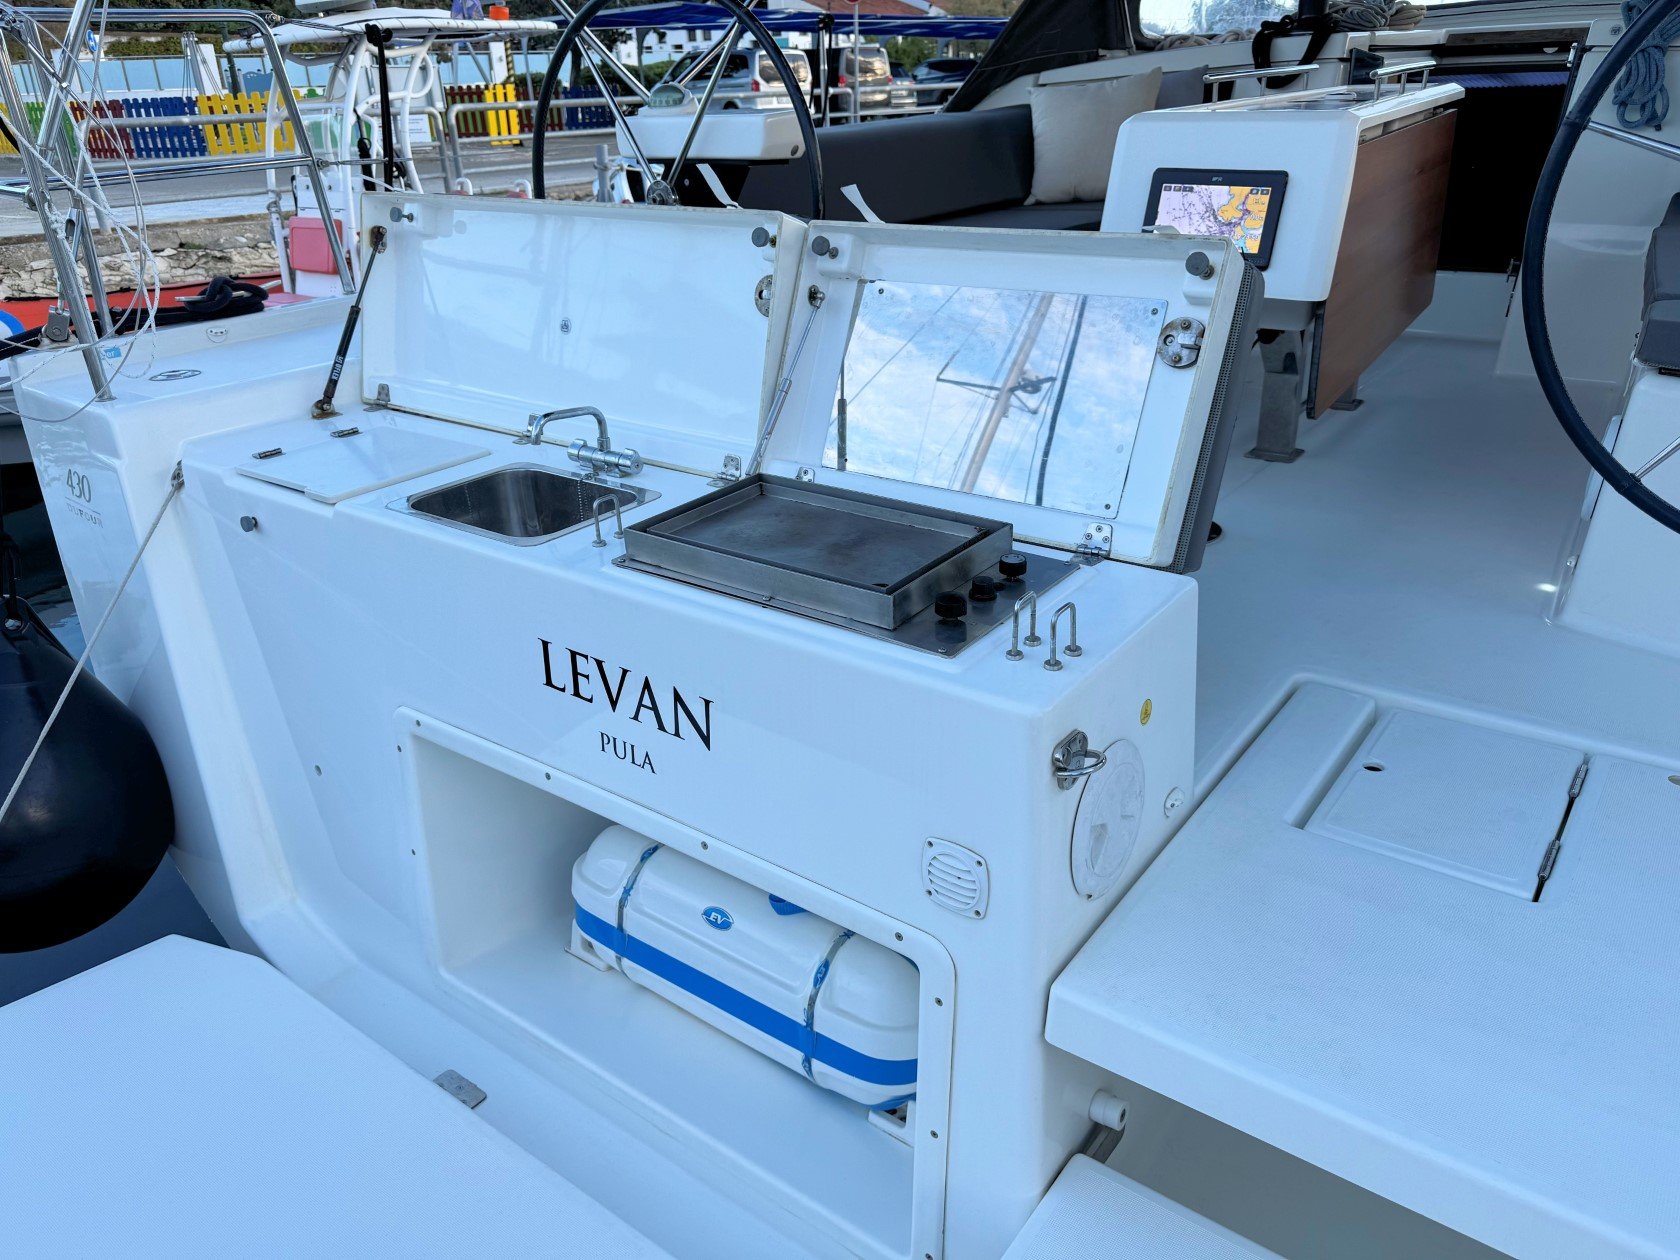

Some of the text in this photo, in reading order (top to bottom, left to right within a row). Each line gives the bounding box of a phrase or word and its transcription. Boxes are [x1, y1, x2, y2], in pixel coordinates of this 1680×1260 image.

[66, 468, 92, 503] 430
[537, 637, 715, 752] LEVAN
[598, 731, 657, 775] PULA
